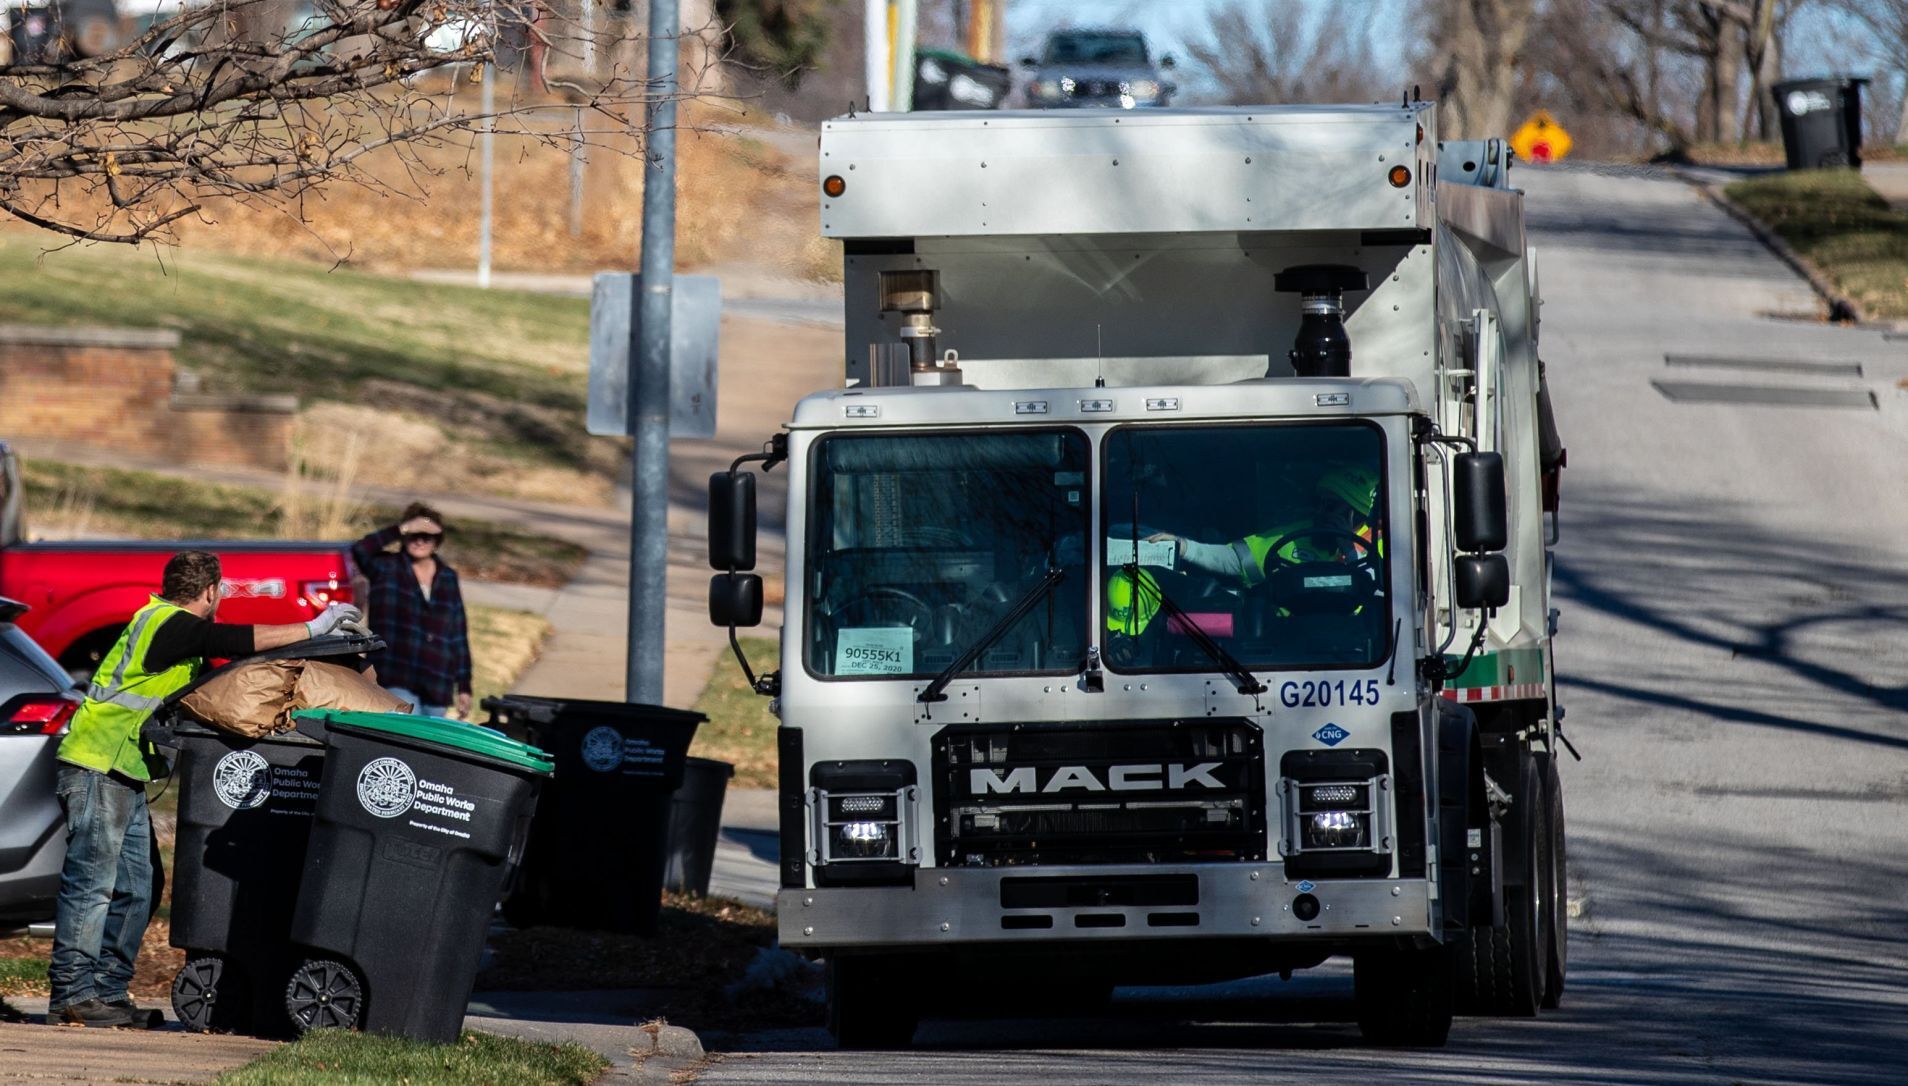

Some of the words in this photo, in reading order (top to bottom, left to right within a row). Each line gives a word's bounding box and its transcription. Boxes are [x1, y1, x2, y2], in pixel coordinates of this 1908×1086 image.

[845, 647, 902, 663] 90555K1
[851, 661, 867, 669] DEC
[868, 663, 881, 671] 25,
[883, 665, 903, 673] 2020
[1280, 679, 1380, 708] G20145
[1321, 730, 1342, 740] CNG
[274, 767, 308, 778] Omaha
[970, 762, 1227, 794] MACK
[273, 778, 301, 789] Public
[302, 780, 320, 789] Wor
[418, 779, 454, 795] Omaha
[272, 789, 319, 799] Departme
[416, 789, 445, 804] Public
[445, 796, 476, 812] Works
[413, 801, 471, 822] Department
